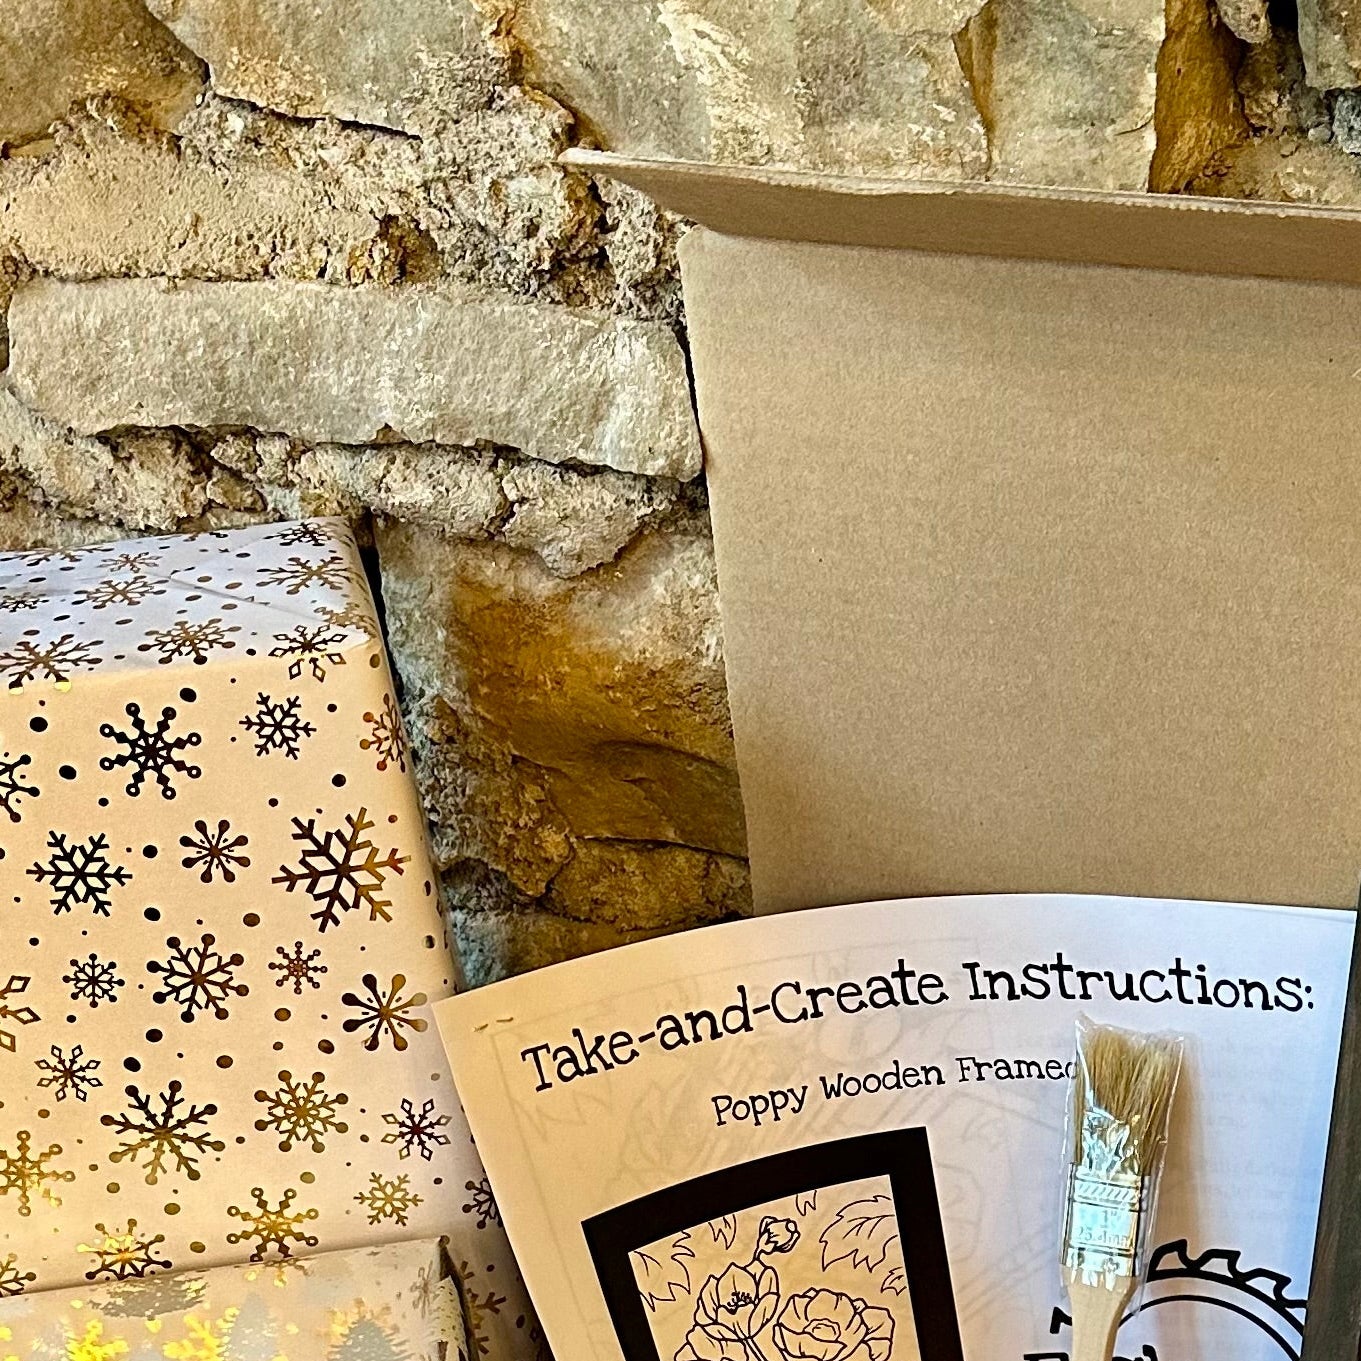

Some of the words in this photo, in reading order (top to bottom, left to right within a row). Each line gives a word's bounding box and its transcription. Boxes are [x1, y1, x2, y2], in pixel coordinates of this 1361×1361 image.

[520, 958, 950, 1093] Take-and-Create
[961, 952, 1315, 1013] Instructions:
[711, 1085, 809, 1127] Poppy
[819, 1059, 946, 1101] Wooden
